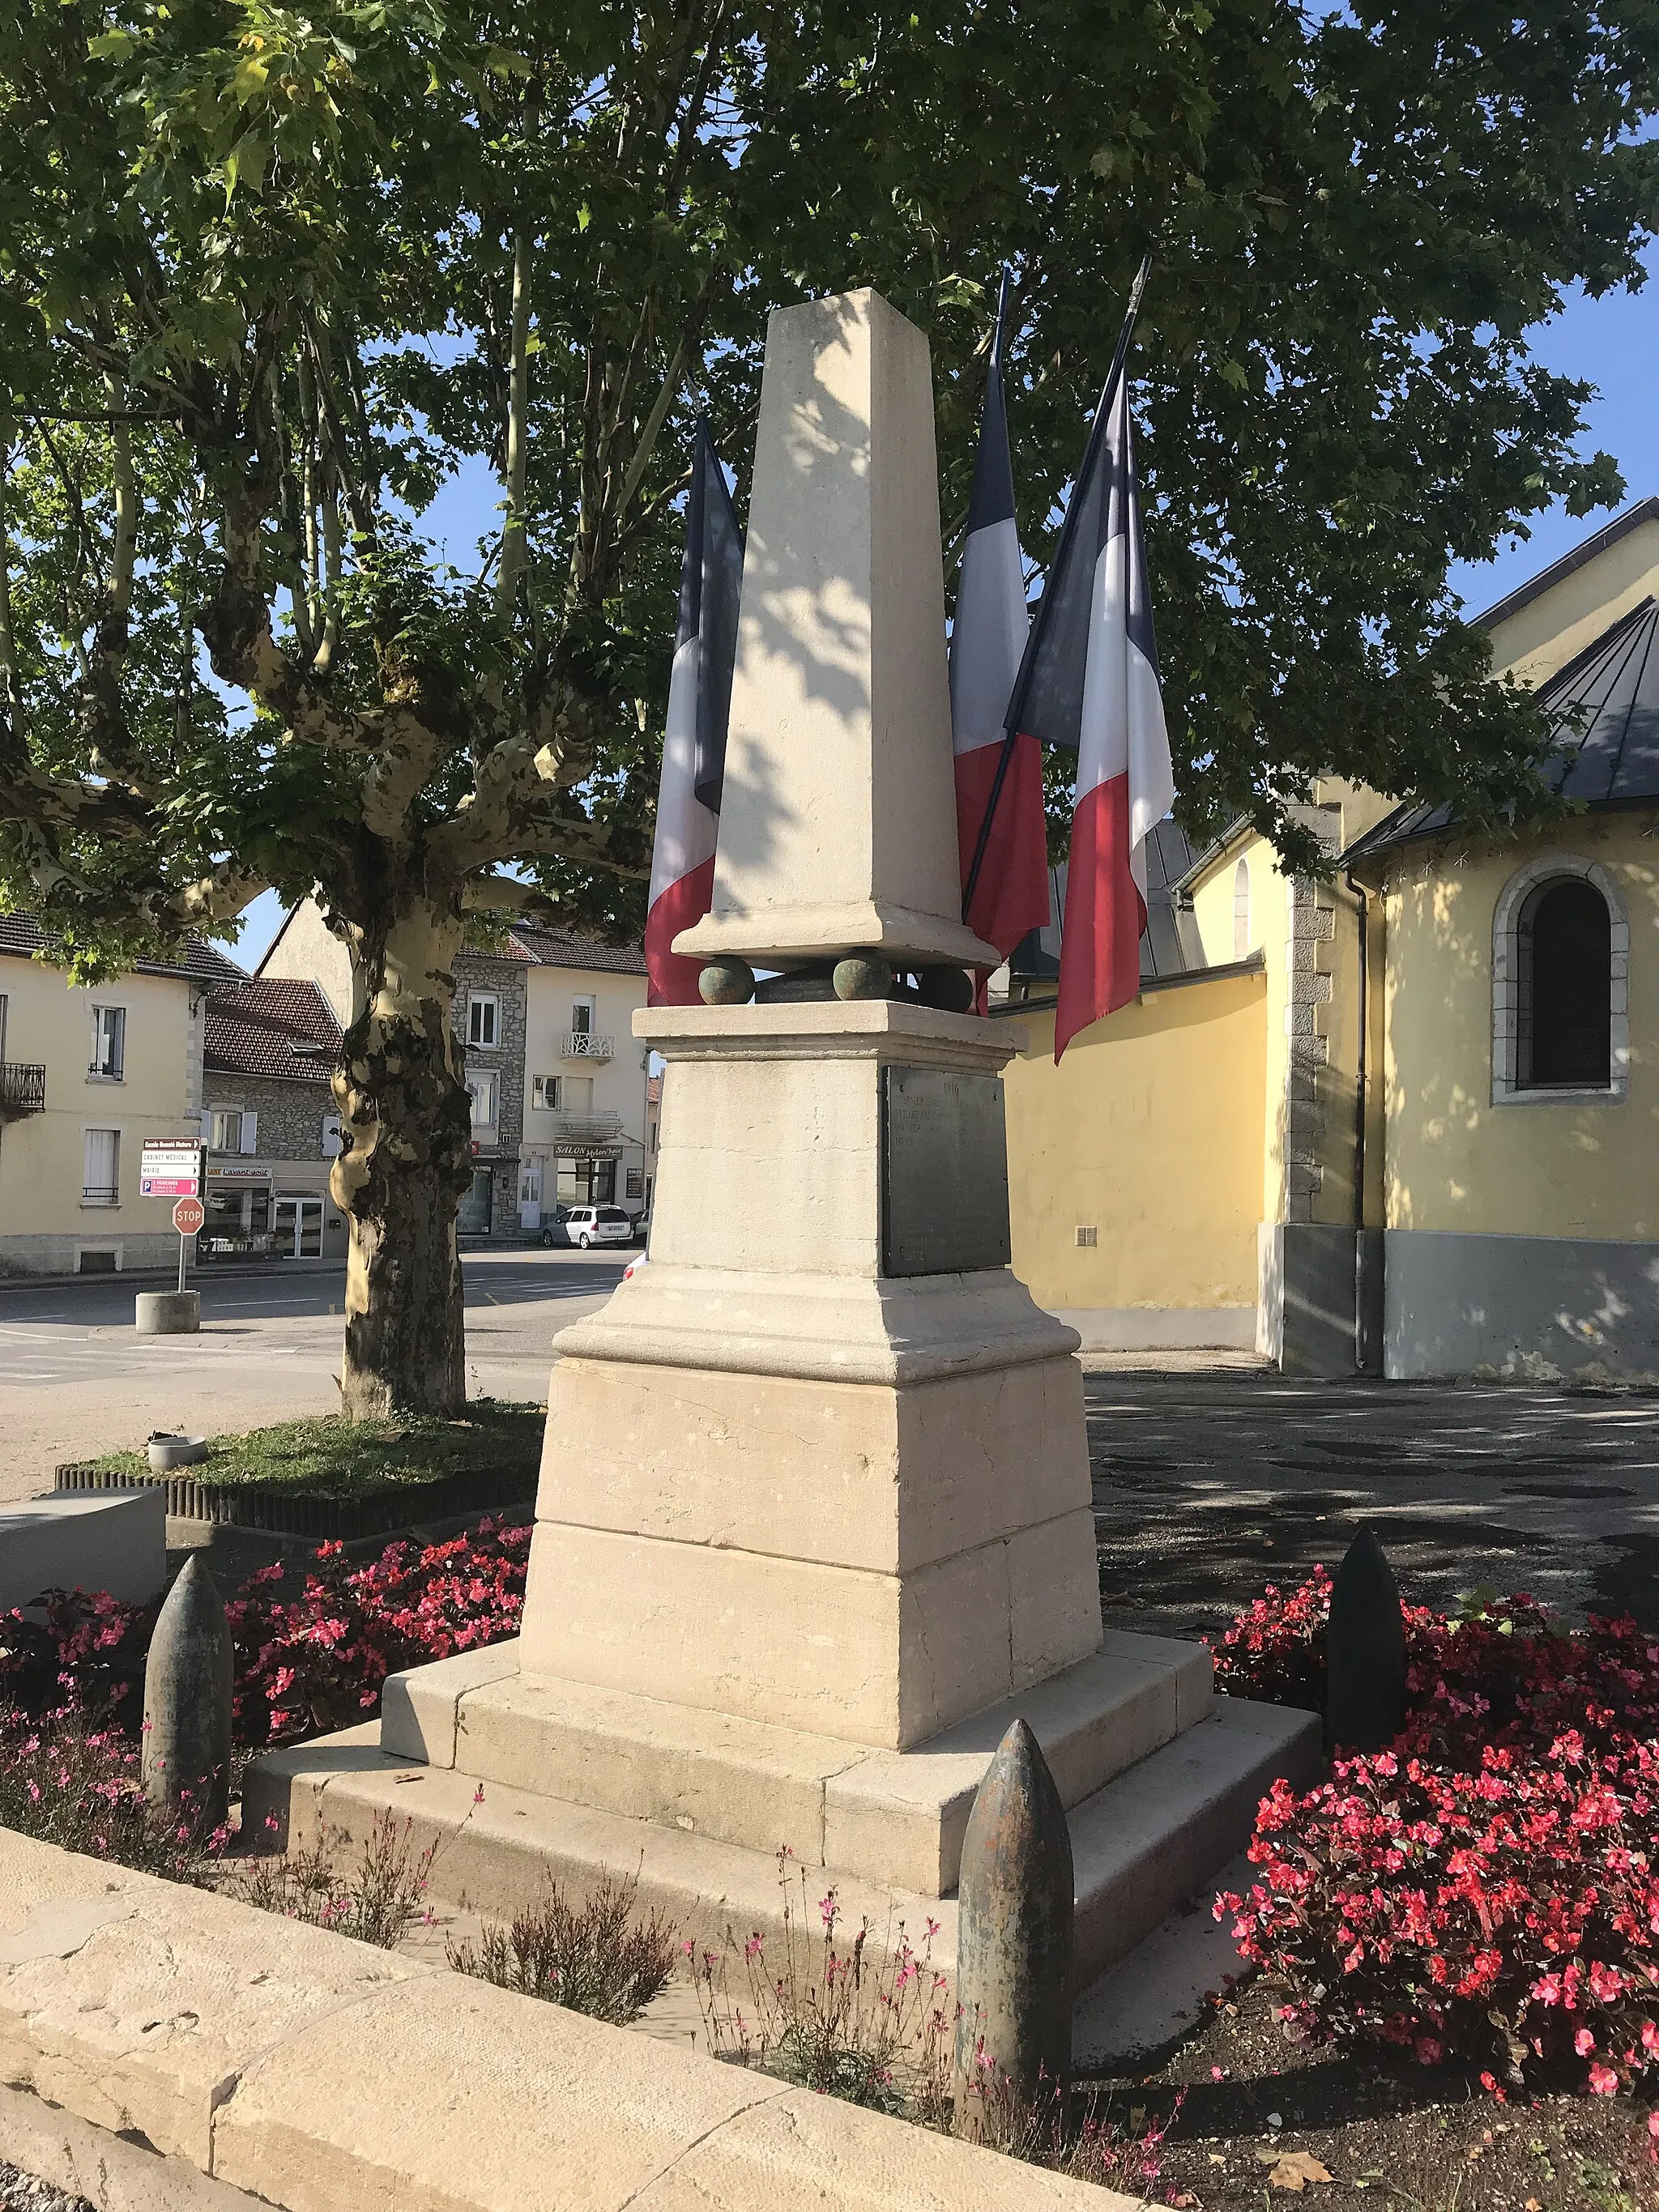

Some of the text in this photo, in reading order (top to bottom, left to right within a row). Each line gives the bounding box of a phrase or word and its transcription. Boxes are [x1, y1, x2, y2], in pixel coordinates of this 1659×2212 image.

[556, 1146, 586, 1154] SALON
[144, 1182, 151, 1191] P
[177, 1210, 201, 1221] STOP
